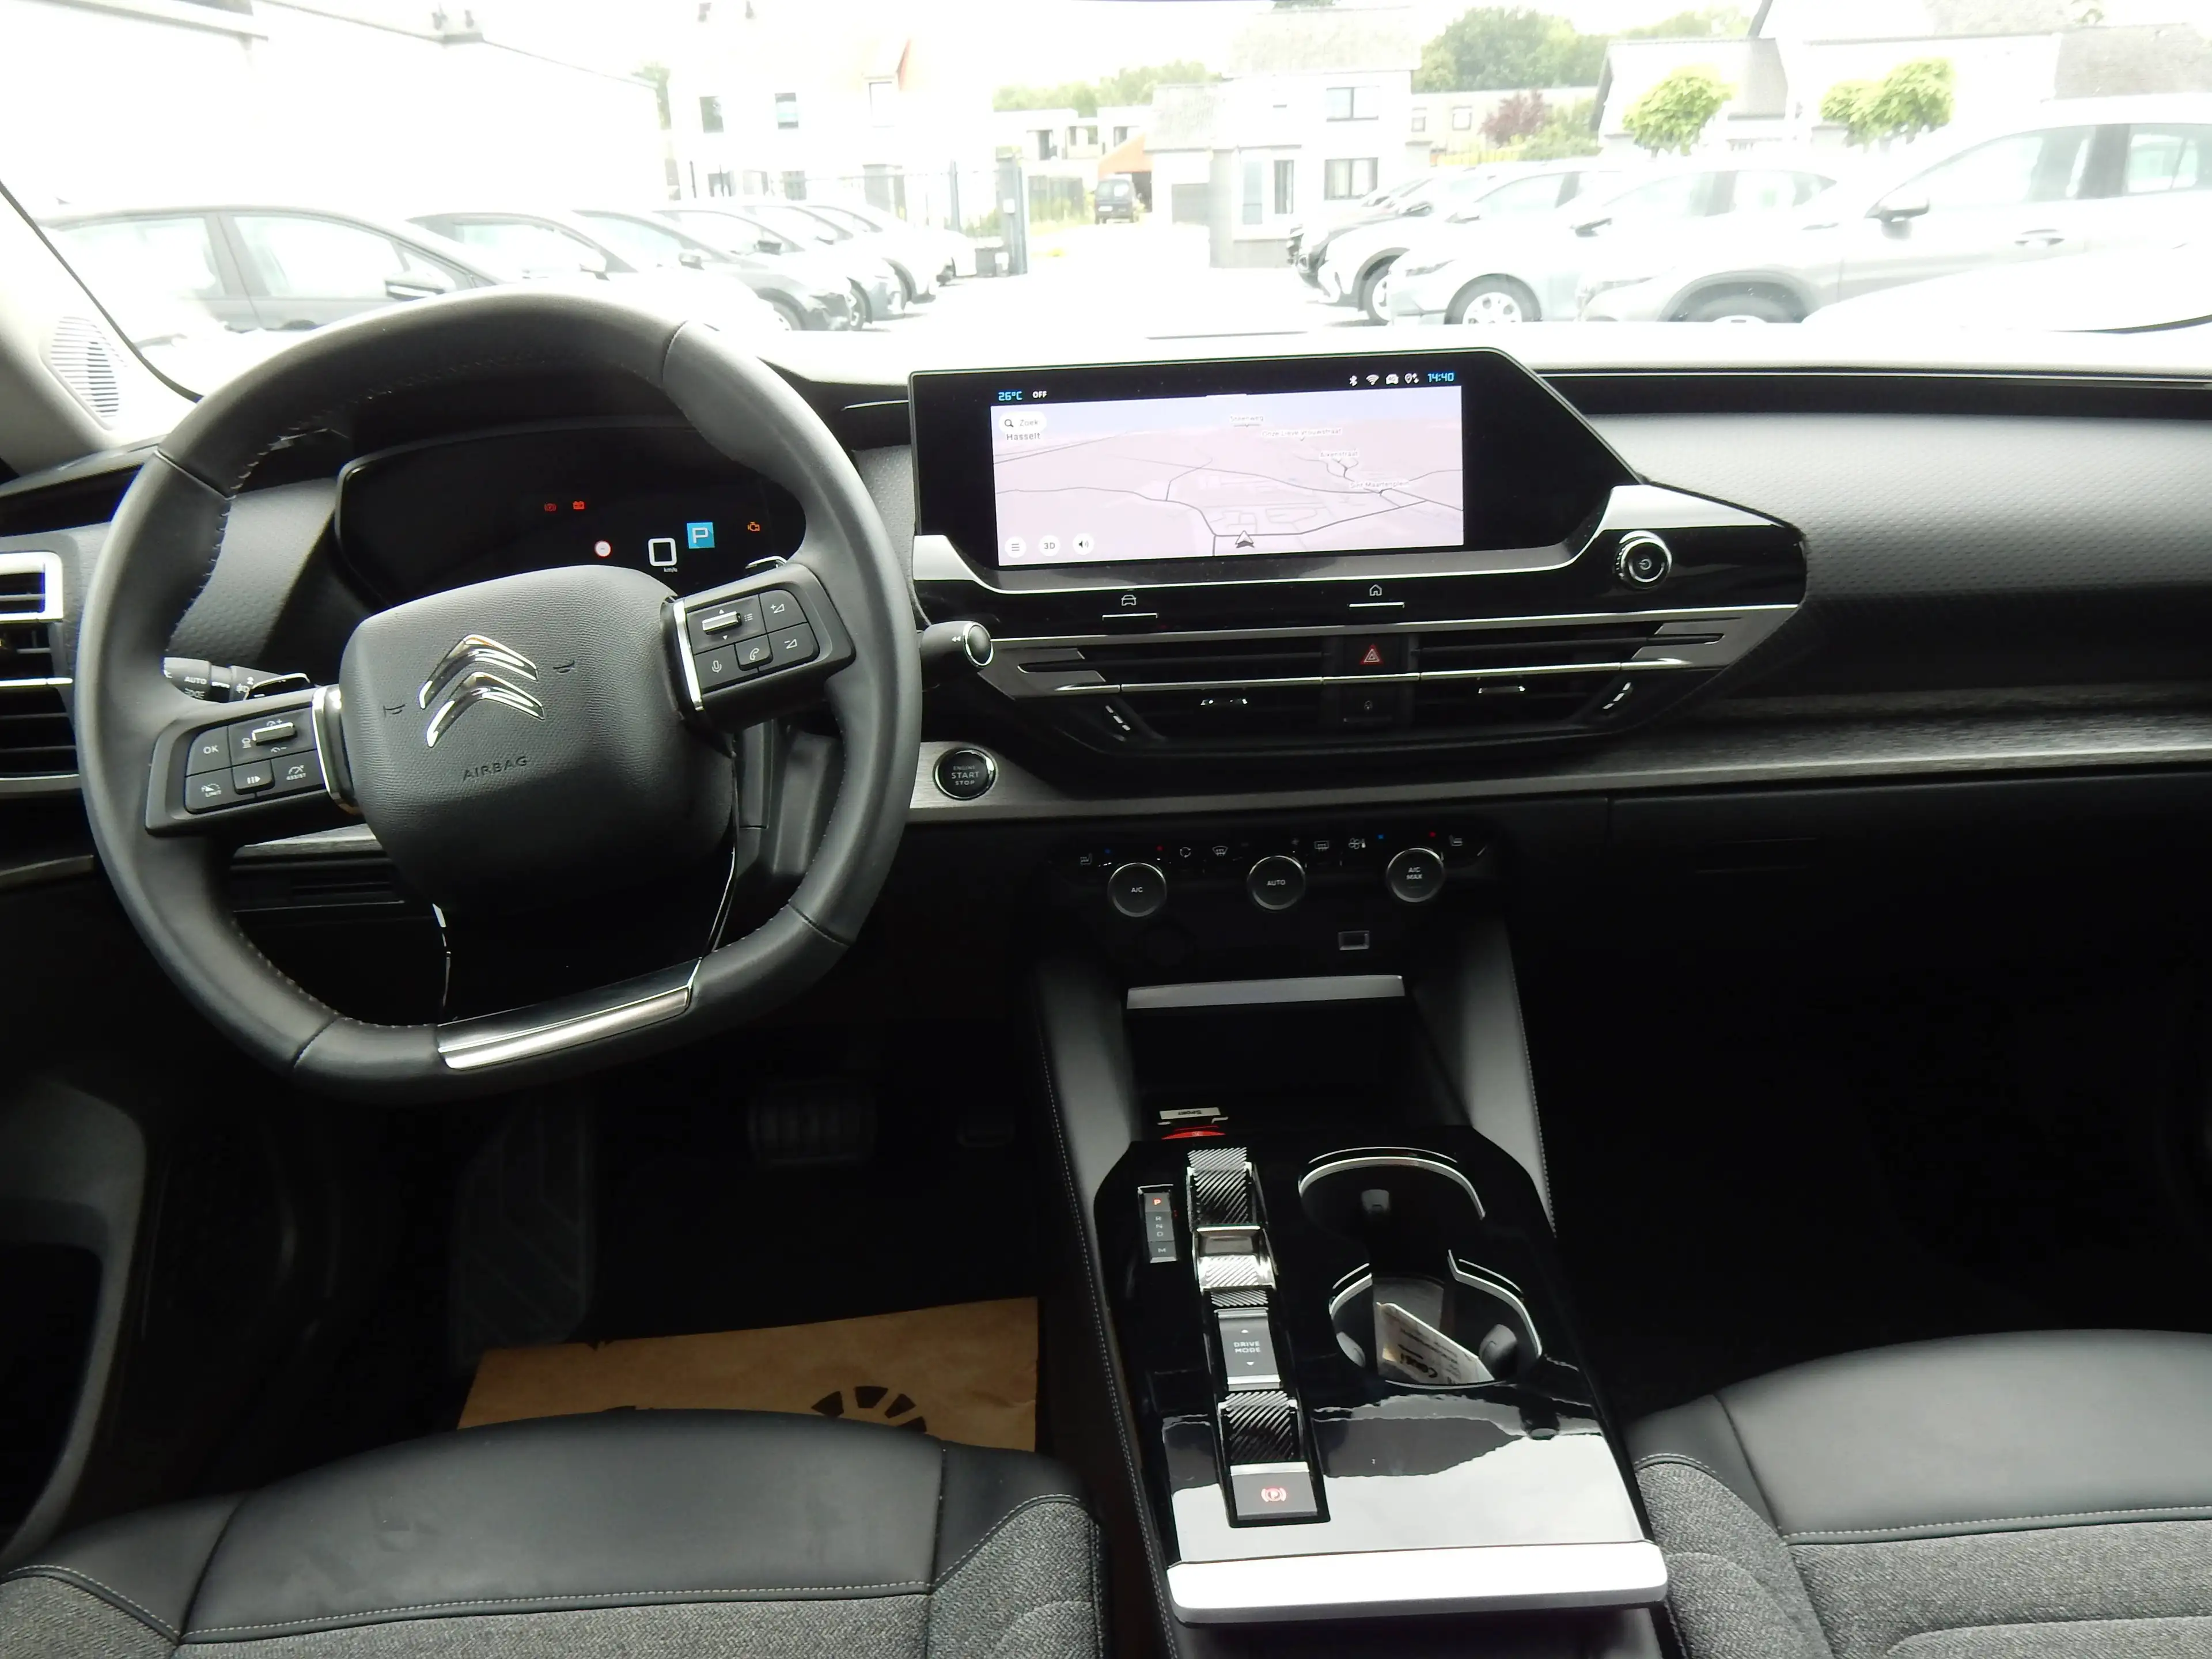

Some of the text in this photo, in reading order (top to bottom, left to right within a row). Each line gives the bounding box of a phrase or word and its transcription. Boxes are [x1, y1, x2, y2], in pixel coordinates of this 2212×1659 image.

[1427, 372, 1455, 382] 14:40
[998, 391, 1047, 402] 26°C OFF
[1006, 433, 1041, 441] Hasselt
[692, 527, 709, 544] P
[648, 537, 677, 566] 0
[184, 676, 207, 685] AUTO
[203, 745, 219, 755] OK
[463, 756, 528, 781] AIRBAG
[951, 771, 979, 779] START
